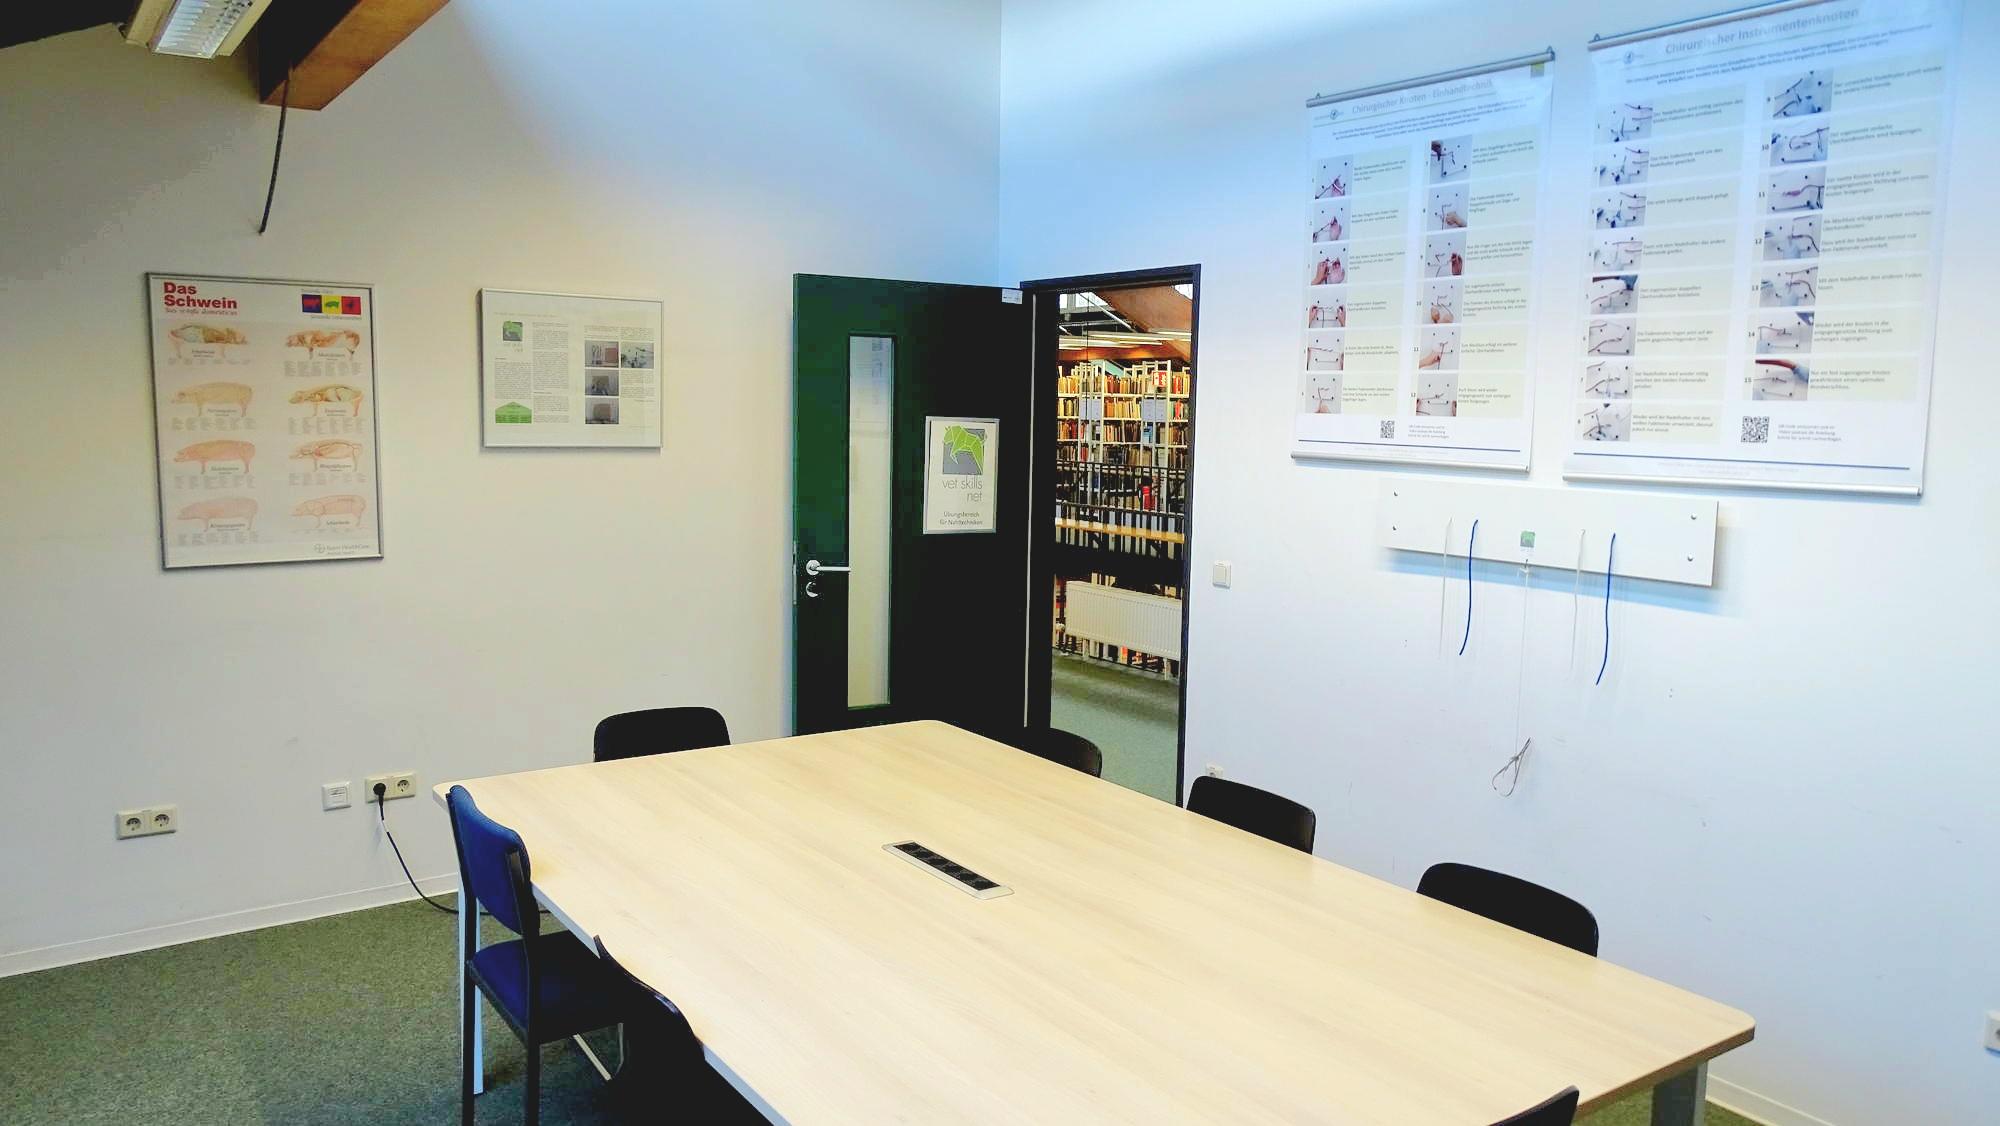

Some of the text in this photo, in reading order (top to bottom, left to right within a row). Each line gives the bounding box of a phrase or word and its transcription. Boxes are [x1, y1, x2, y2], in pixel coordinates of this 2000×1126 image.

[1665, 34, 1735, 54] Chirurgicher
[164, 282, 197, 295] Das
[164, 294, 238, 309] Schwein
[941, 475, 983, 490] vet skills
[966, 491, 983, 502] net
